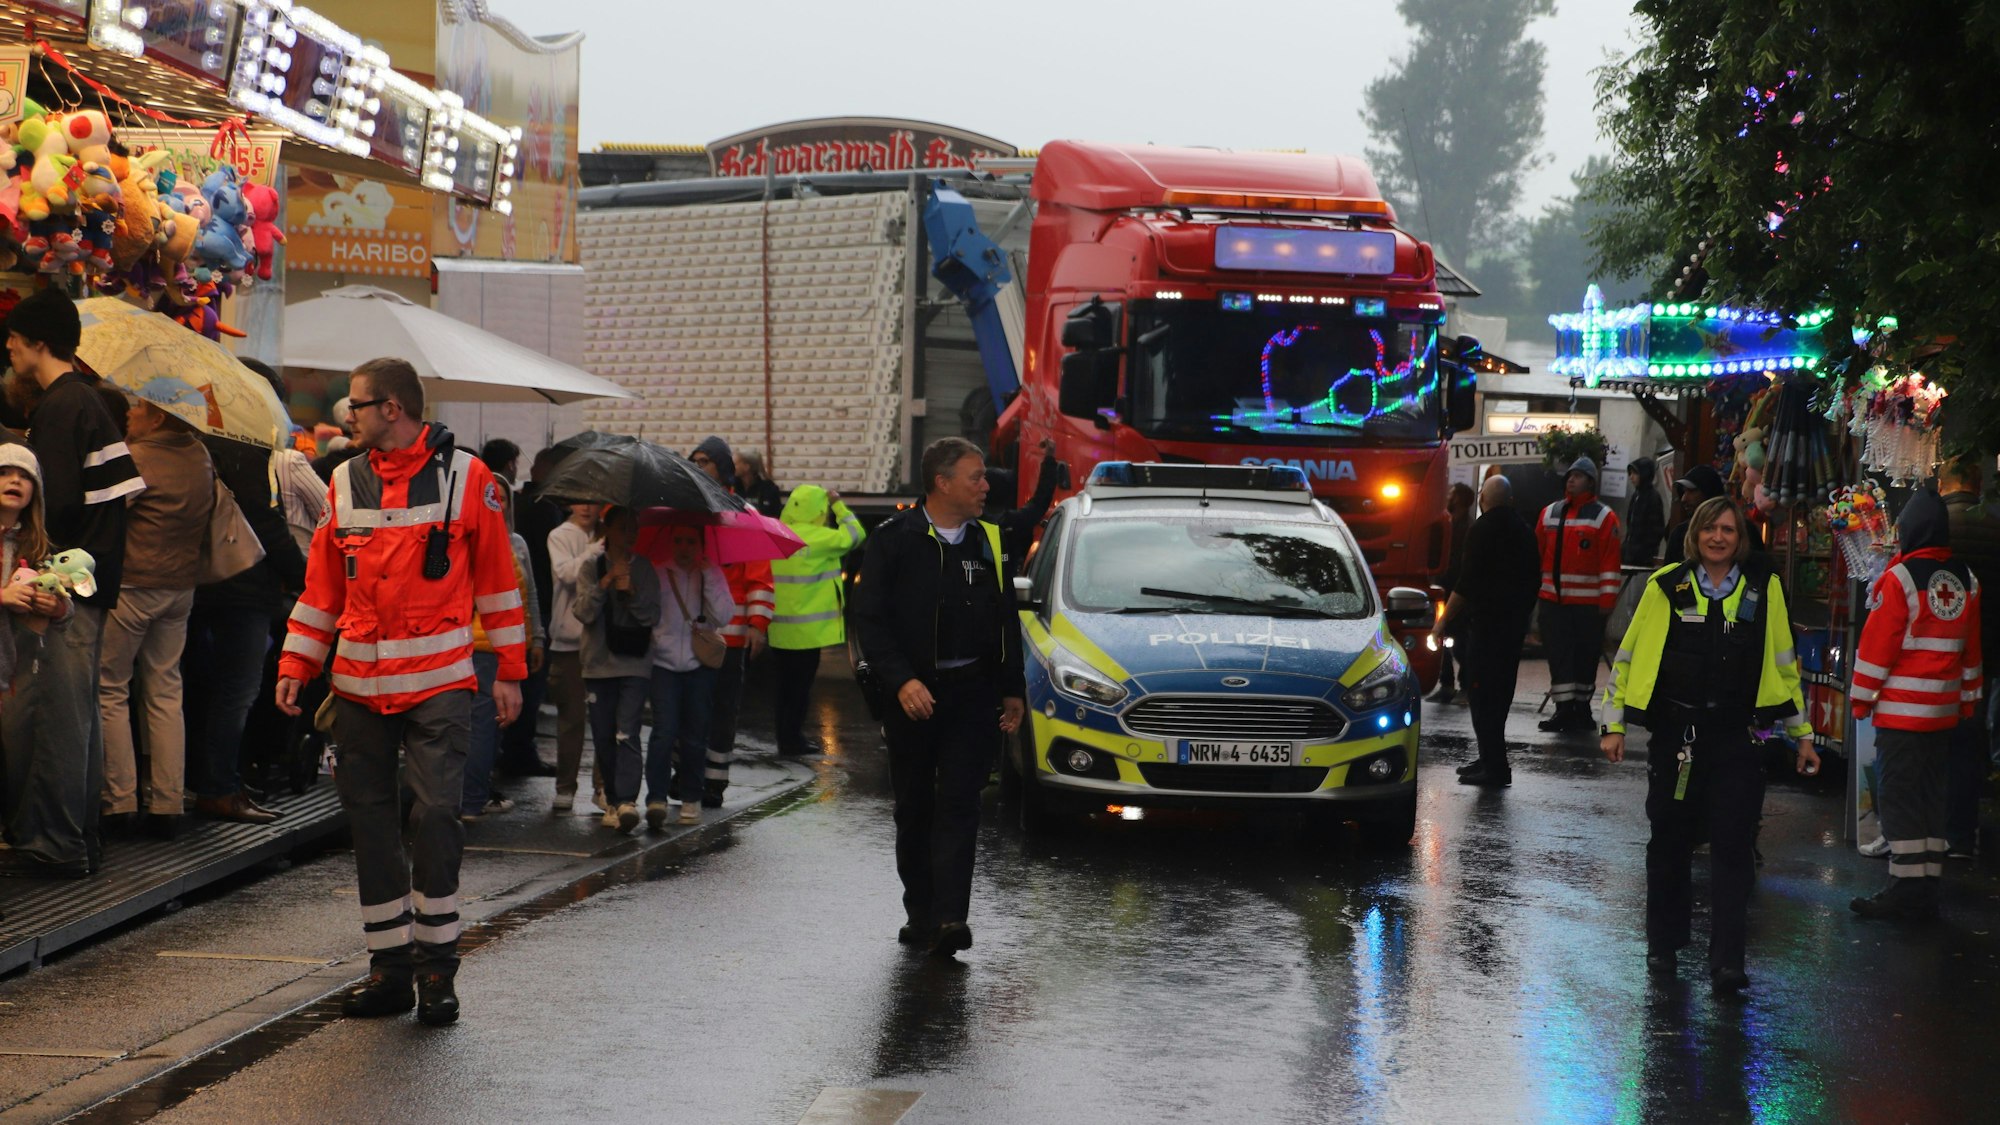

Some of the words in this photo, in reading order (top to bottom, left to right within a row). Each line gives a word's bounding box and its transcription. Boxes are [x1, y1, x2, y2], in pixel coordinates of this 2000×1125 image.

[718, 131, 916, 176] Schwarzwald
[332, 241, 427, 264] HARIBO
[1512, 417, 1538, 433] Sion
[240, 434, 252, 444] City
[1149, 632, 1311, 650] POLIZEI
[1190, 744, 1221, 762] NRW
[1230, 744, 1290, 763] 4-6435
